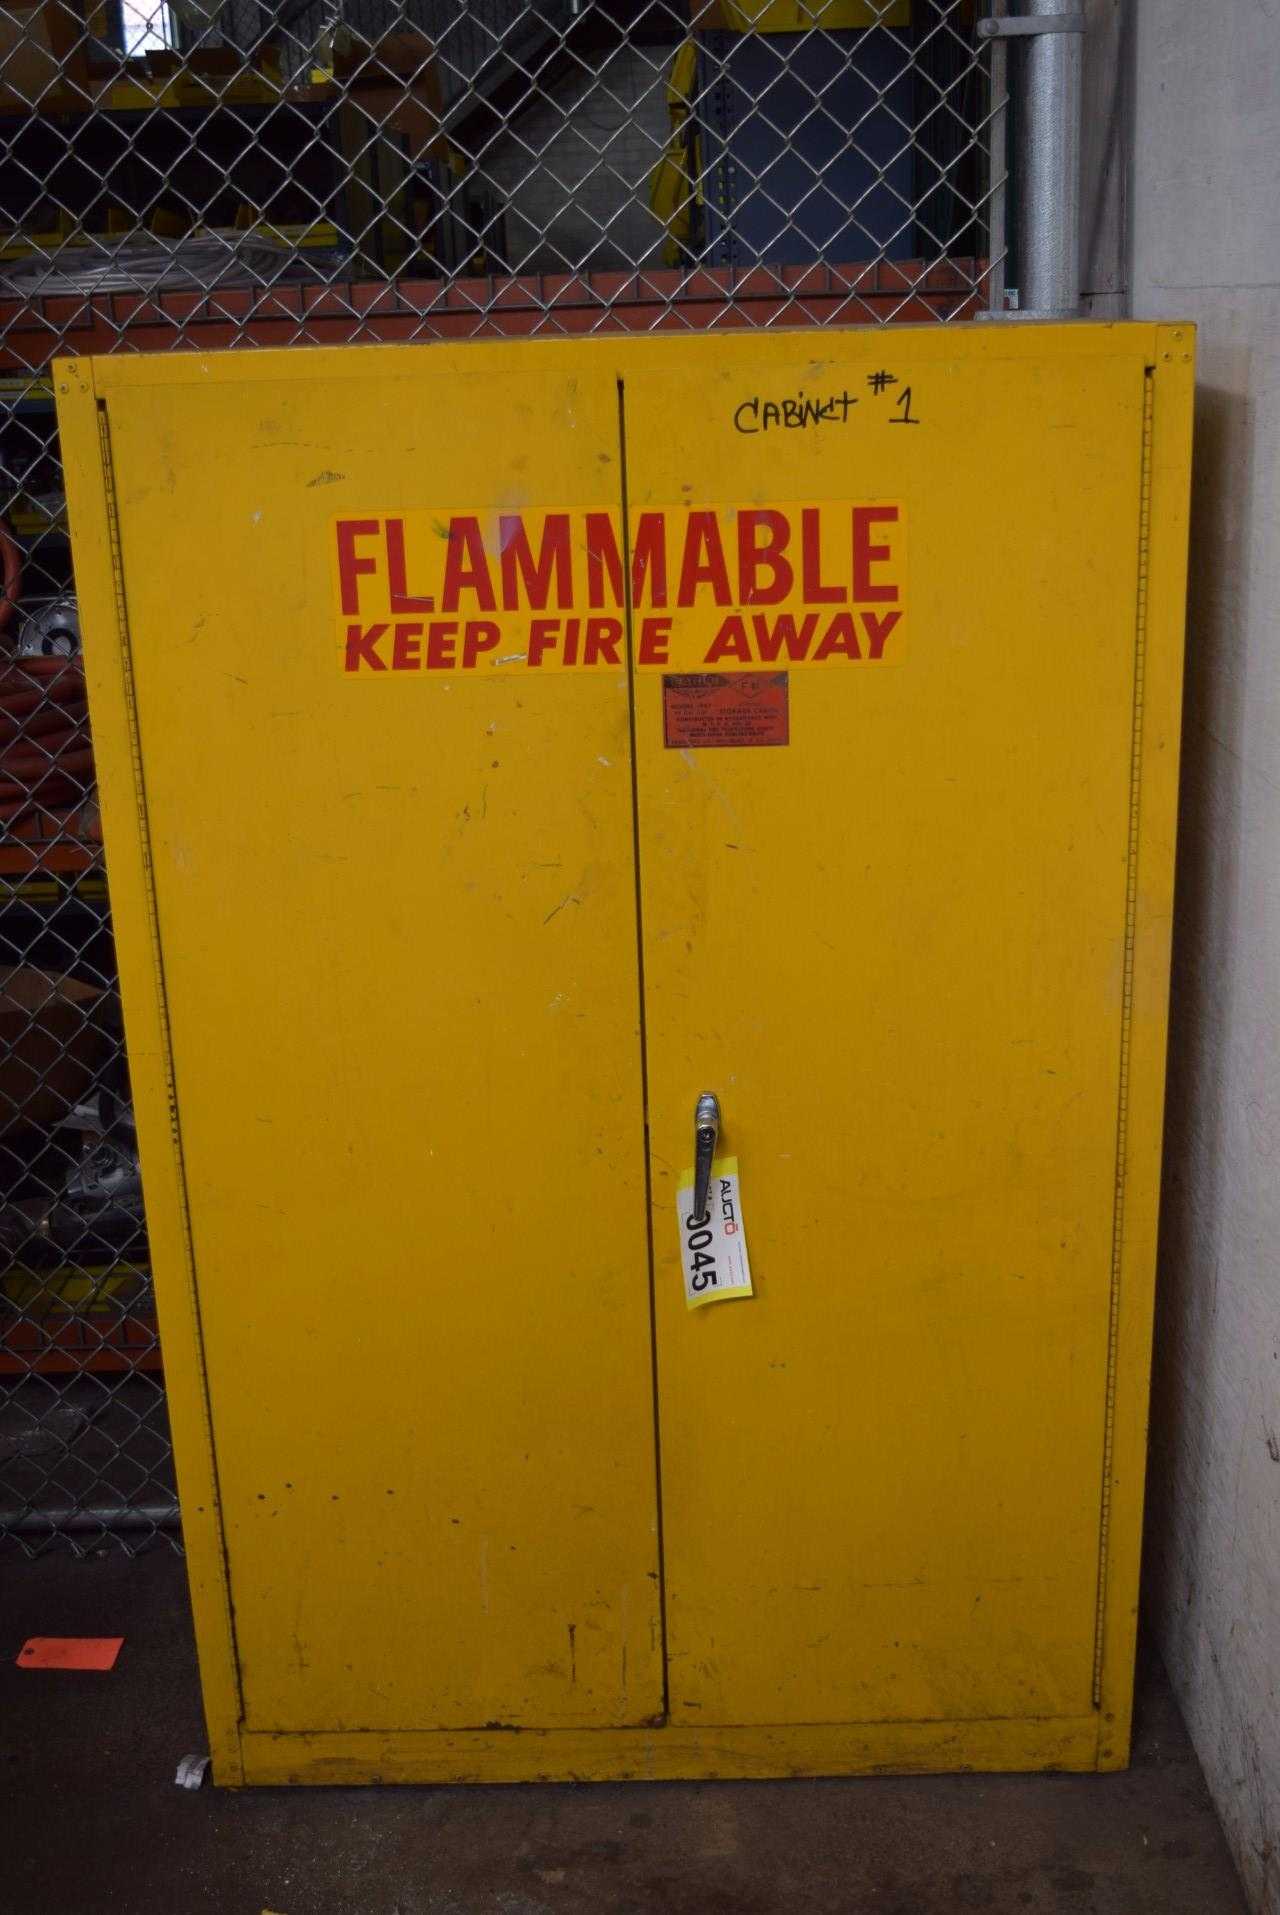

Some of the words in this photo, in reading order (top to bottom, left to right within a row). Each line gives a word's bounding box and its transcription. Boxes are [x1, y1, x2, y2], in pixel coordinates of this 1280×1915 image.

[335, 505, 900, 616] FLAMMABLE
[344, 620, 501, 672] KEEP
[527, 616, 673, 667] FIRE
[702, 610, 903, 664] AWAY
[719, 1178, 739, 1235] AUCTO
